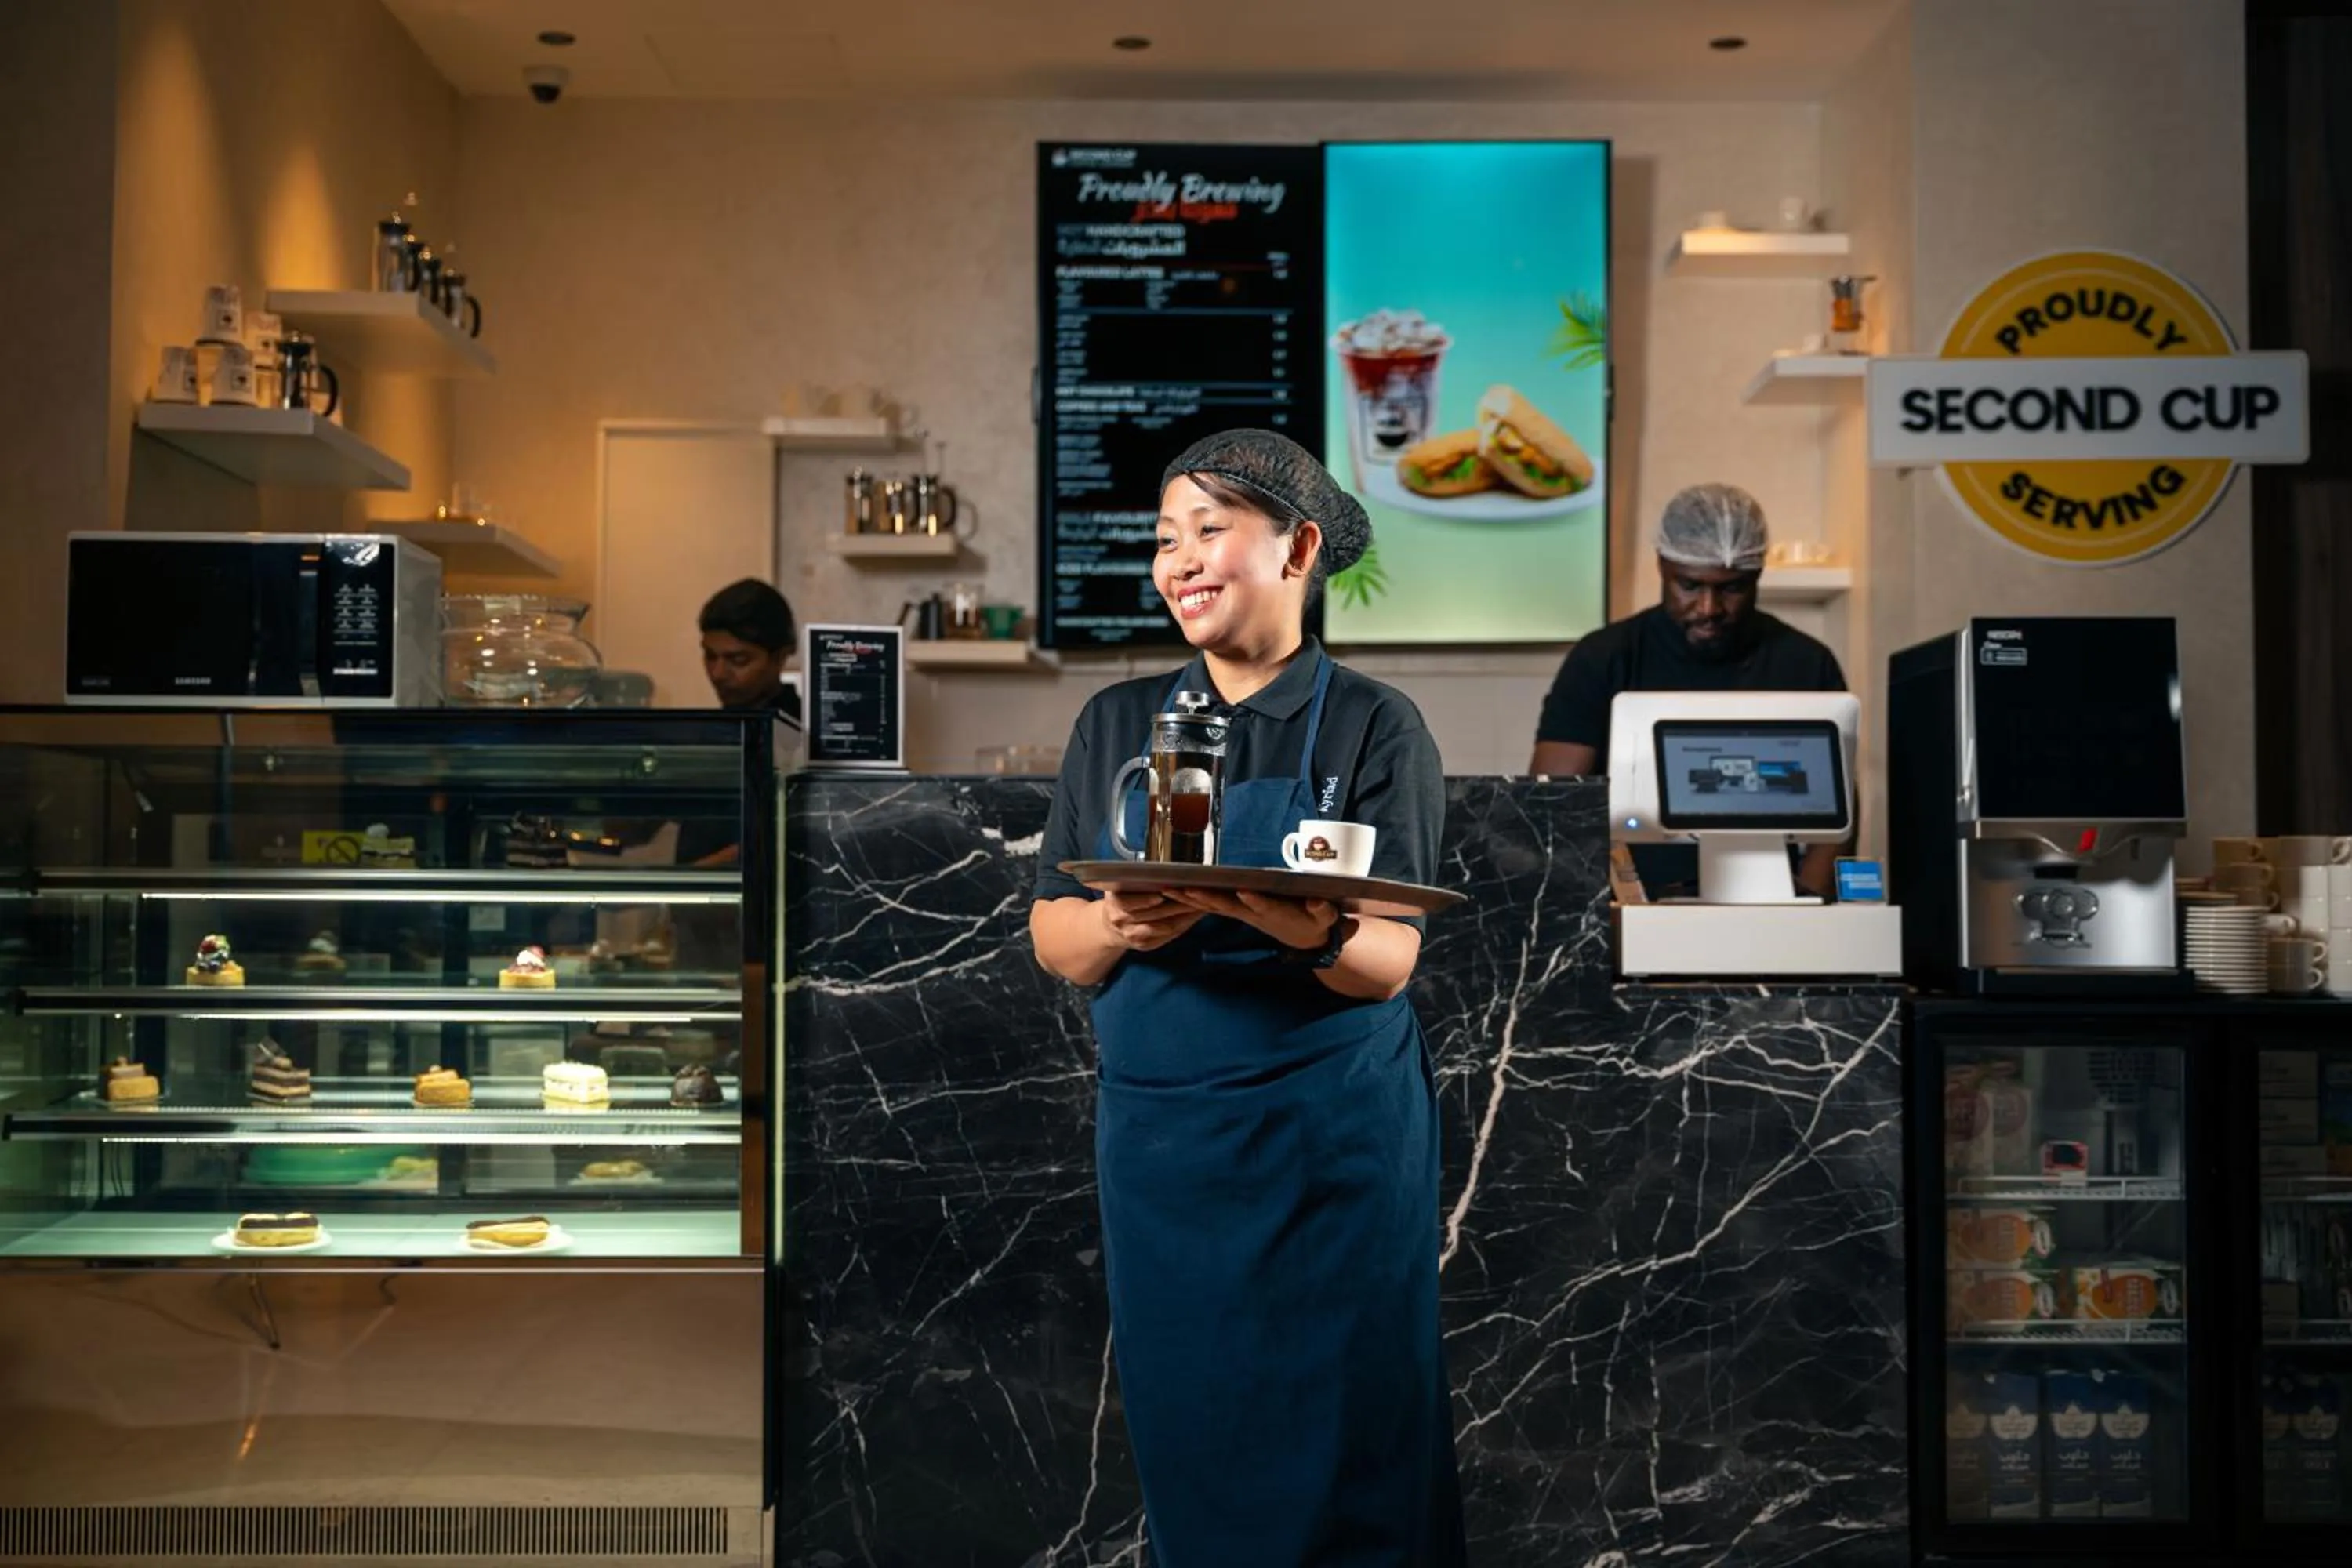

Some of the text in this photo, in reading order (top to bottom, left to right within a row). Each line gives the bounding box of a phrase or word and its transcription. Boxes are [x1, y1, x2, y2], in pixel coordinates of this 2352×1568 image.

[1077, 170, 1177, 212] Proudly
[1181, 173, 1287, 213] Brewing
[1995, 289, 2188, 356] PROUDLY
[1900, 386, 2281, 432] SECOND CUP
[2000, 465, 2187, 531] SERVING
